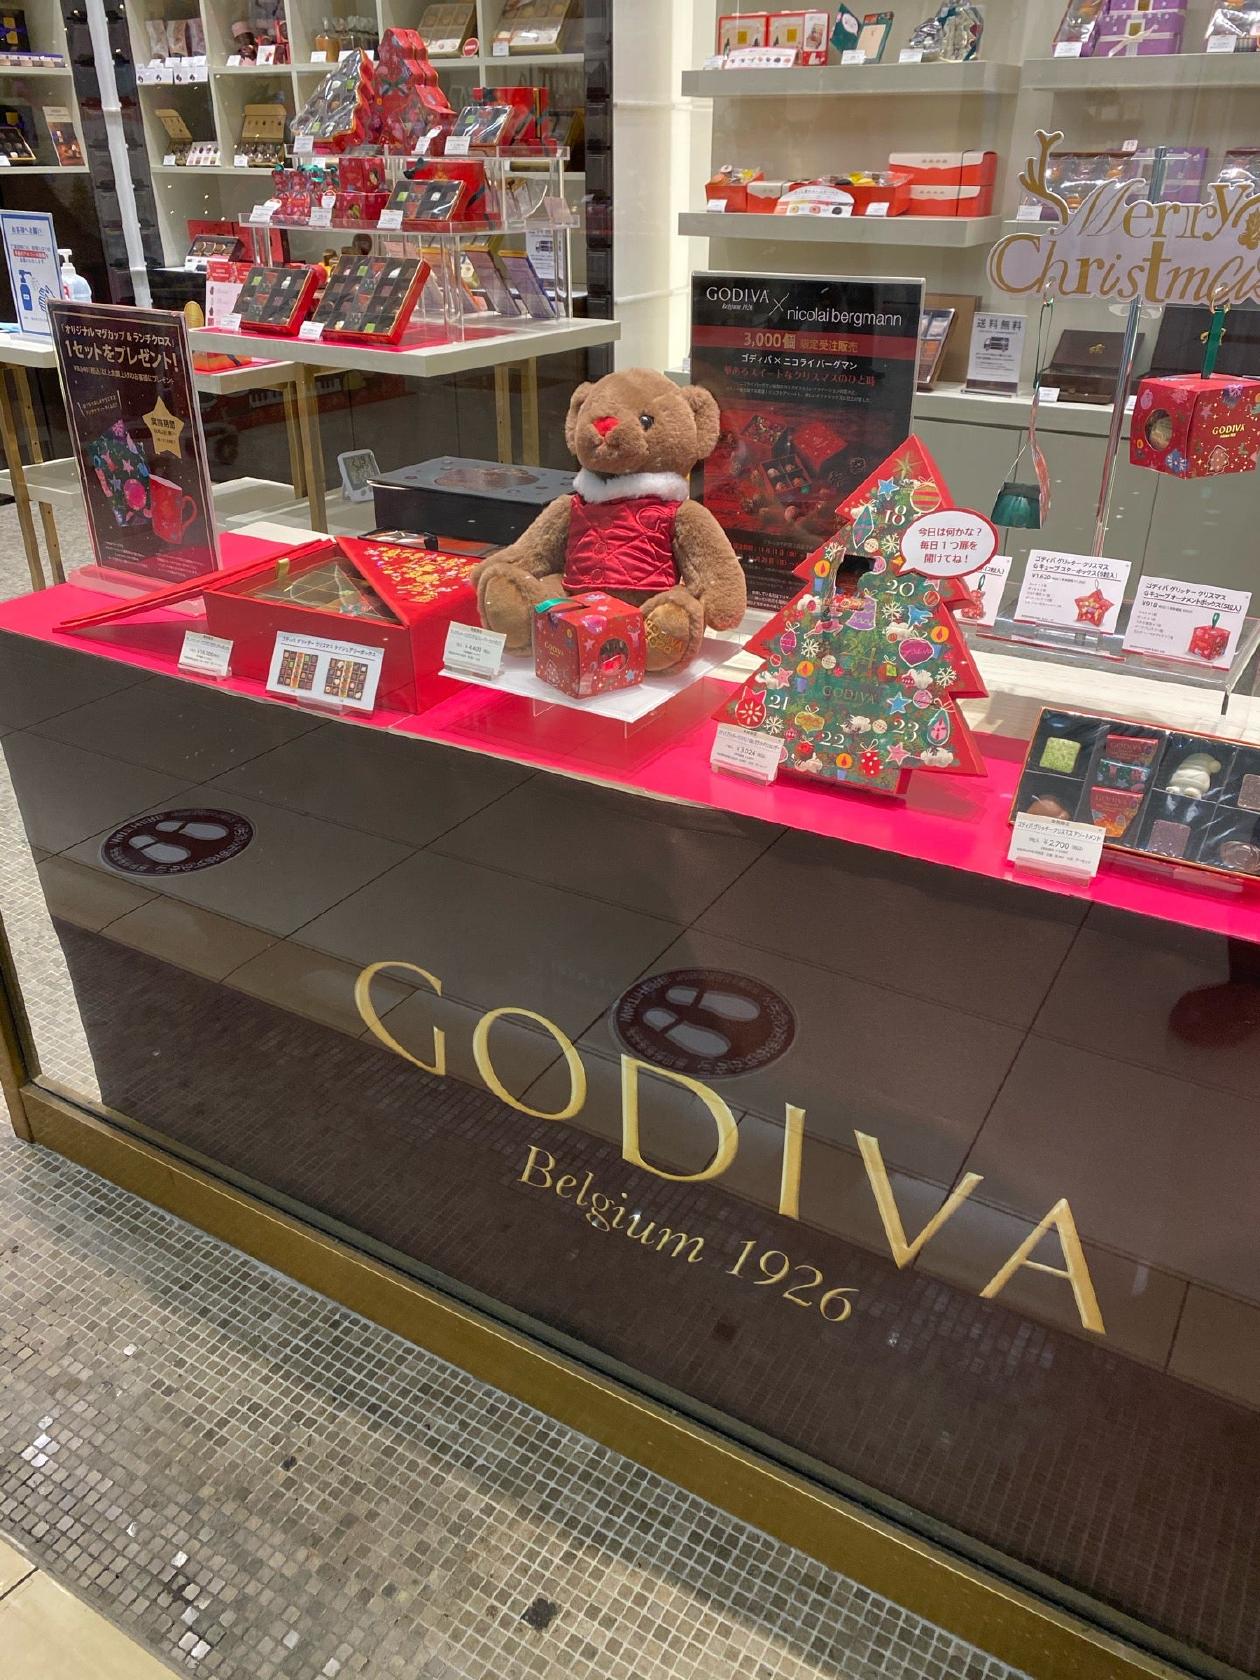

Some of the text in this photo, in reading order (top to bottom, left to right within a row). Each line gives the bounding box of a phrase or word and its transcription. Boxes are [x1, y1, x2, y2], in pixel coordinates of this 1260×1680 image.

[1054, 178, 1249, 242] Merry
[706, 286, 769, 303] GODIVA
[743, 332, 796, 350] 3,000個
[1212, 423, 1246, 435] GODIVA
[885, 505, 907, 525] 18
[885, 579, 915, 597] 20
[769, 694, 789, 711] 21
[819, 730, 846, 749] 22
[892, 718, 920, 743] 23
[354, 961, 1106, 1335] GODIVA
[517, 1144, 862, 1324] Belgium 1926
